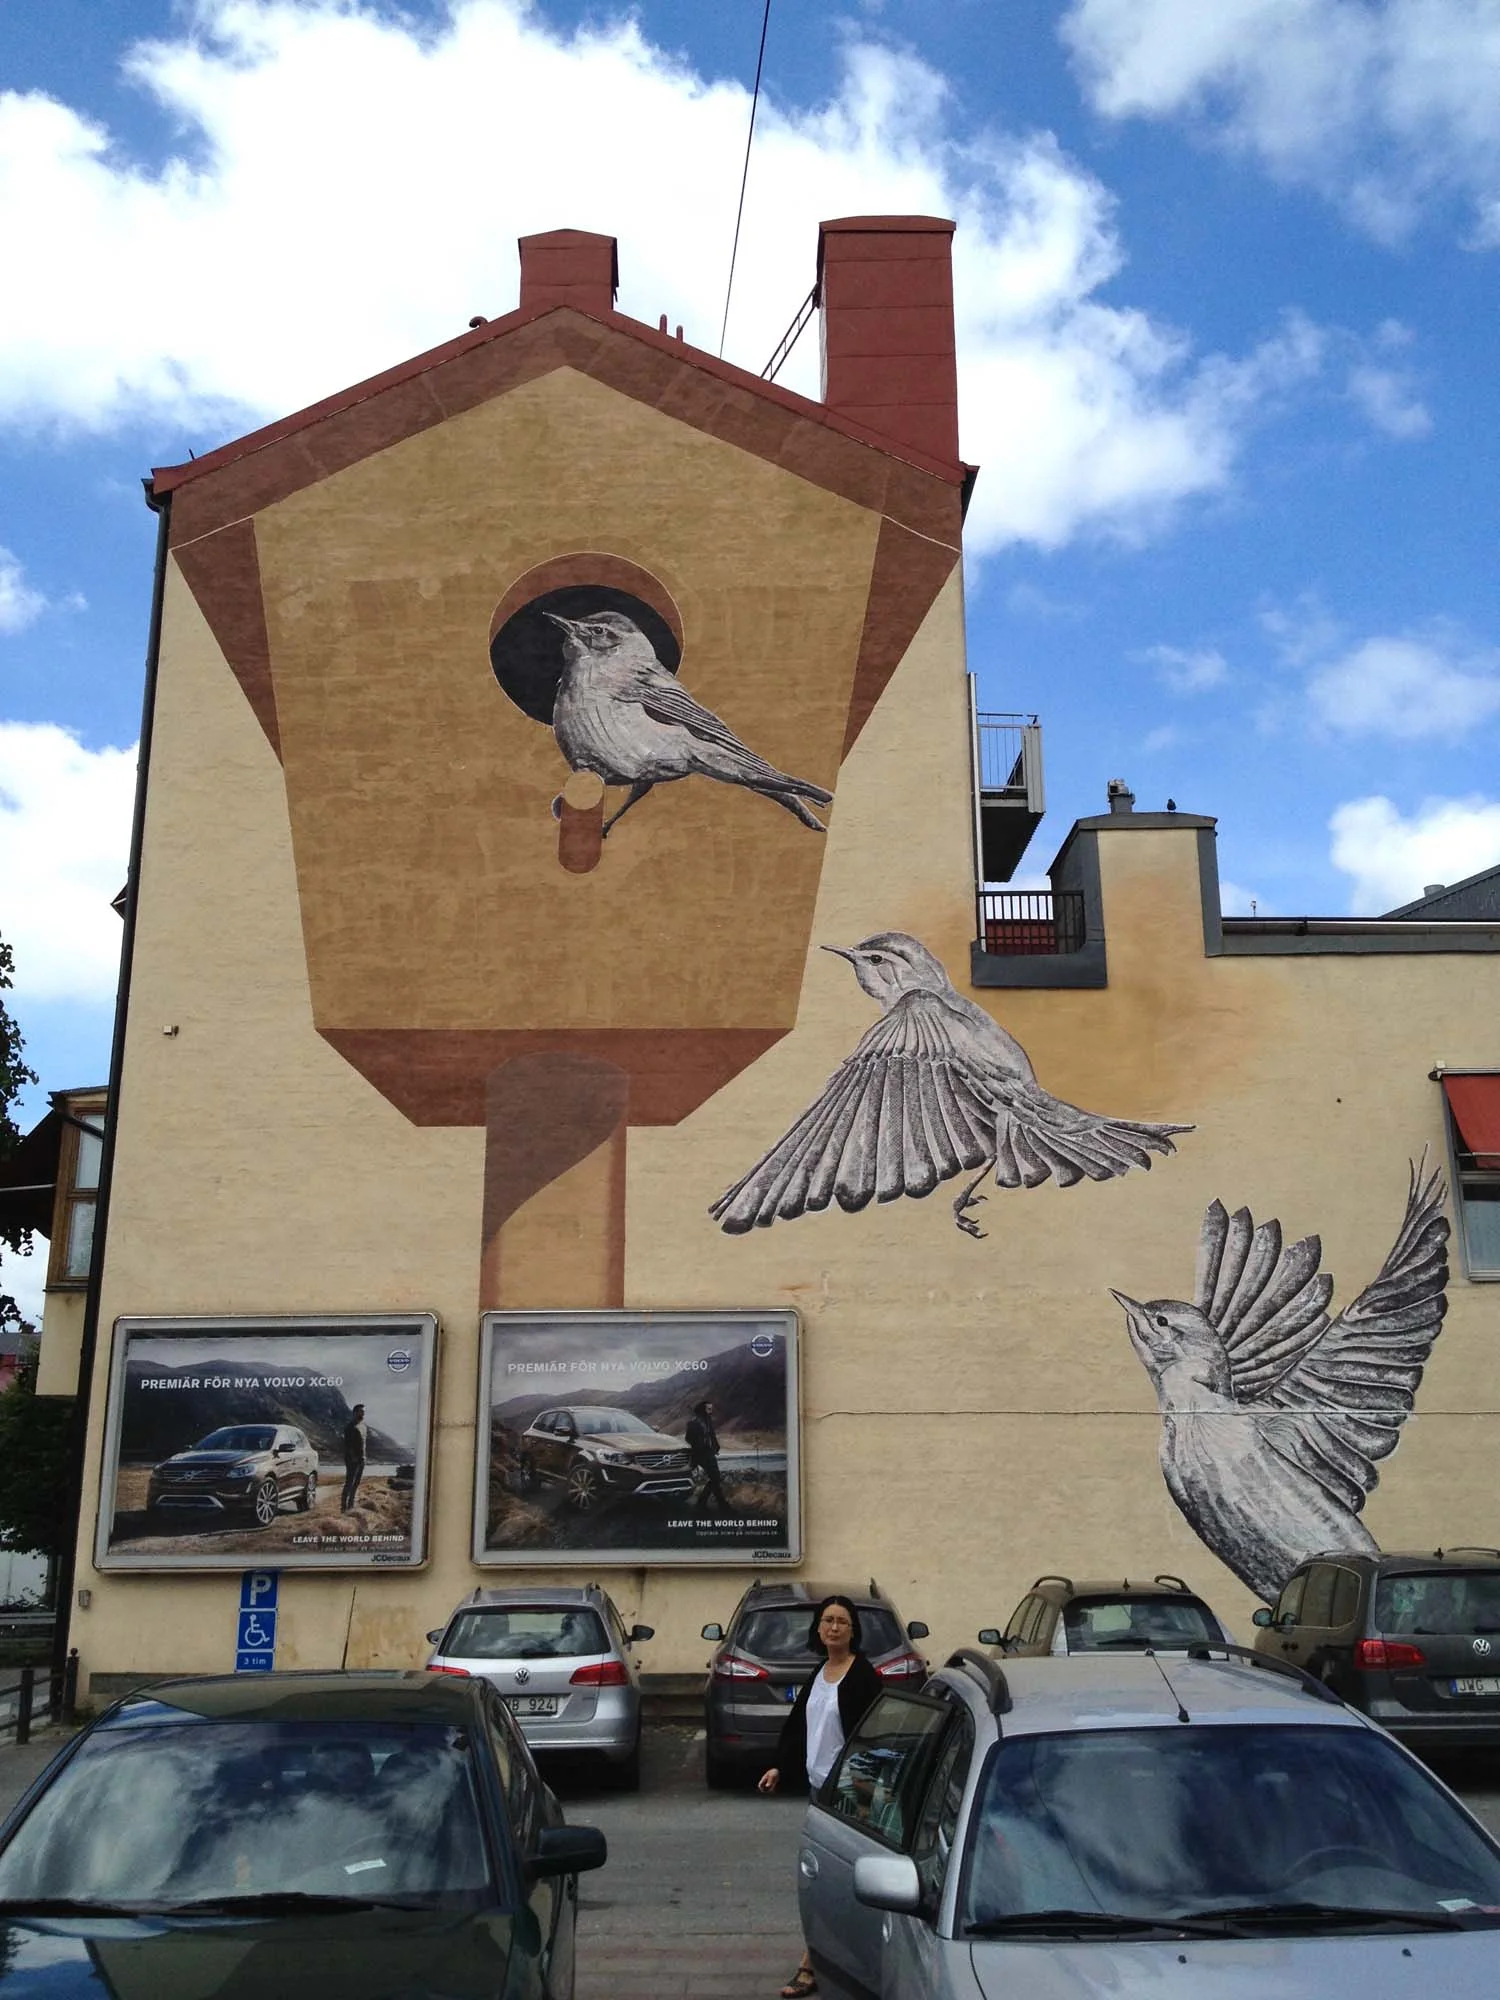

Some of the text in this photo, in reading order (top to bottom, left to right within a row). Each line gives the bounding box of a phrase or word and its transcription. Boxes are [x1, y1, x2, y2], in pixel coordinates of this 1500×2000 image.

[508, 1360, 708, 1374] PREMIÄR FÖR NYA VOLVO XC60
[140, 1376, 344, 1390] PREMIÄR FÖR NYA VOLVO XC60
[667, 1520, 693, 1528] LEAVE
[746, 1519, 778, 1527] BEHIND
[292, 1536, 319, 1544] LEAVE
[321, 1535, 337, 1543] THE
[339, 1535, 370, 1543] WORLD
[249, 1573, 272, 1606] P
[243, 1656, 267, 1665] 3 tim
[1460, 1679, 1484, 1691] JWG
[529, 1697, 553, 1711] 924
